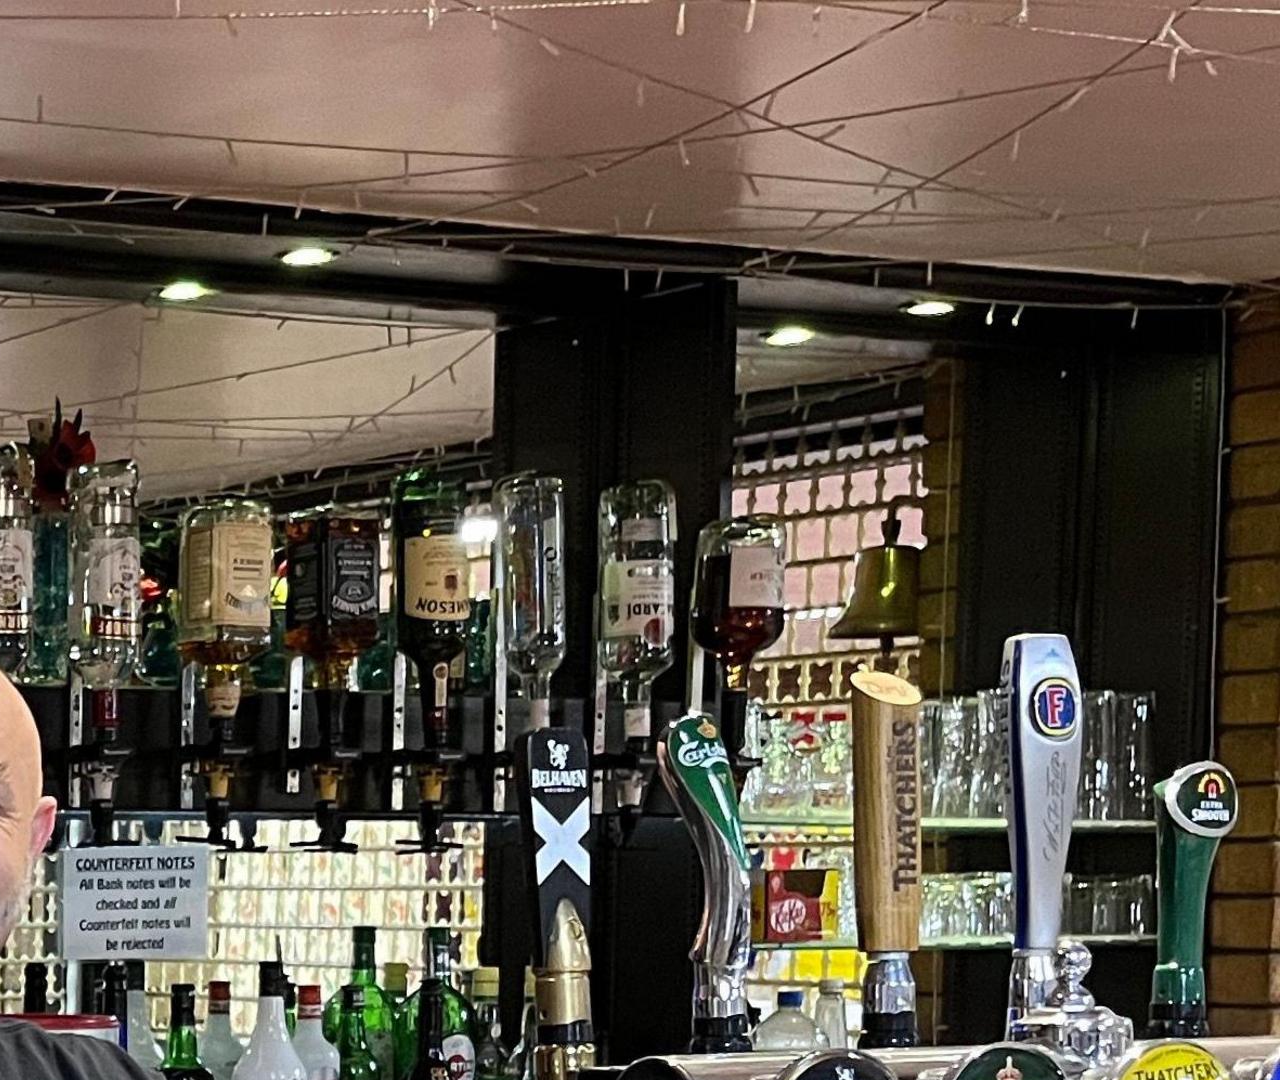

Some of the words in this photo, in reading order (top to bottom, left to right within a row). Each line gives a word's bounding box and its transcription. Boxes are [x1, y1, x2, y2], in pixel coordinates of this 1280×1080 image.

[1045, 687, 1067, 727] F
[531, 768, 587, 788] BELHAVEN
[893, 721, 917, 891] THATCHERS
[76, 857, 153, 871] COUNTERFEIT
[157, 856, 195, 870] NOTES
[79, 879, 94, 890] All
[97, 878, 123, 890] Bank
[126, 878, 155, 890] notes
[158, 877, 176, 889] will
[179, 876, 192, 889] be
[96, 898, 138, 910] checked
[141, 897, 160, 910] and
[164, 897, 178, 909] all
[79, 918, 139, 931] Counterfeit
[142, 918, 171, 930] notes
[174, 915, 191, 928] will
[106, 939, 118, 951] be
[121, 937, 164, 950] rejected
